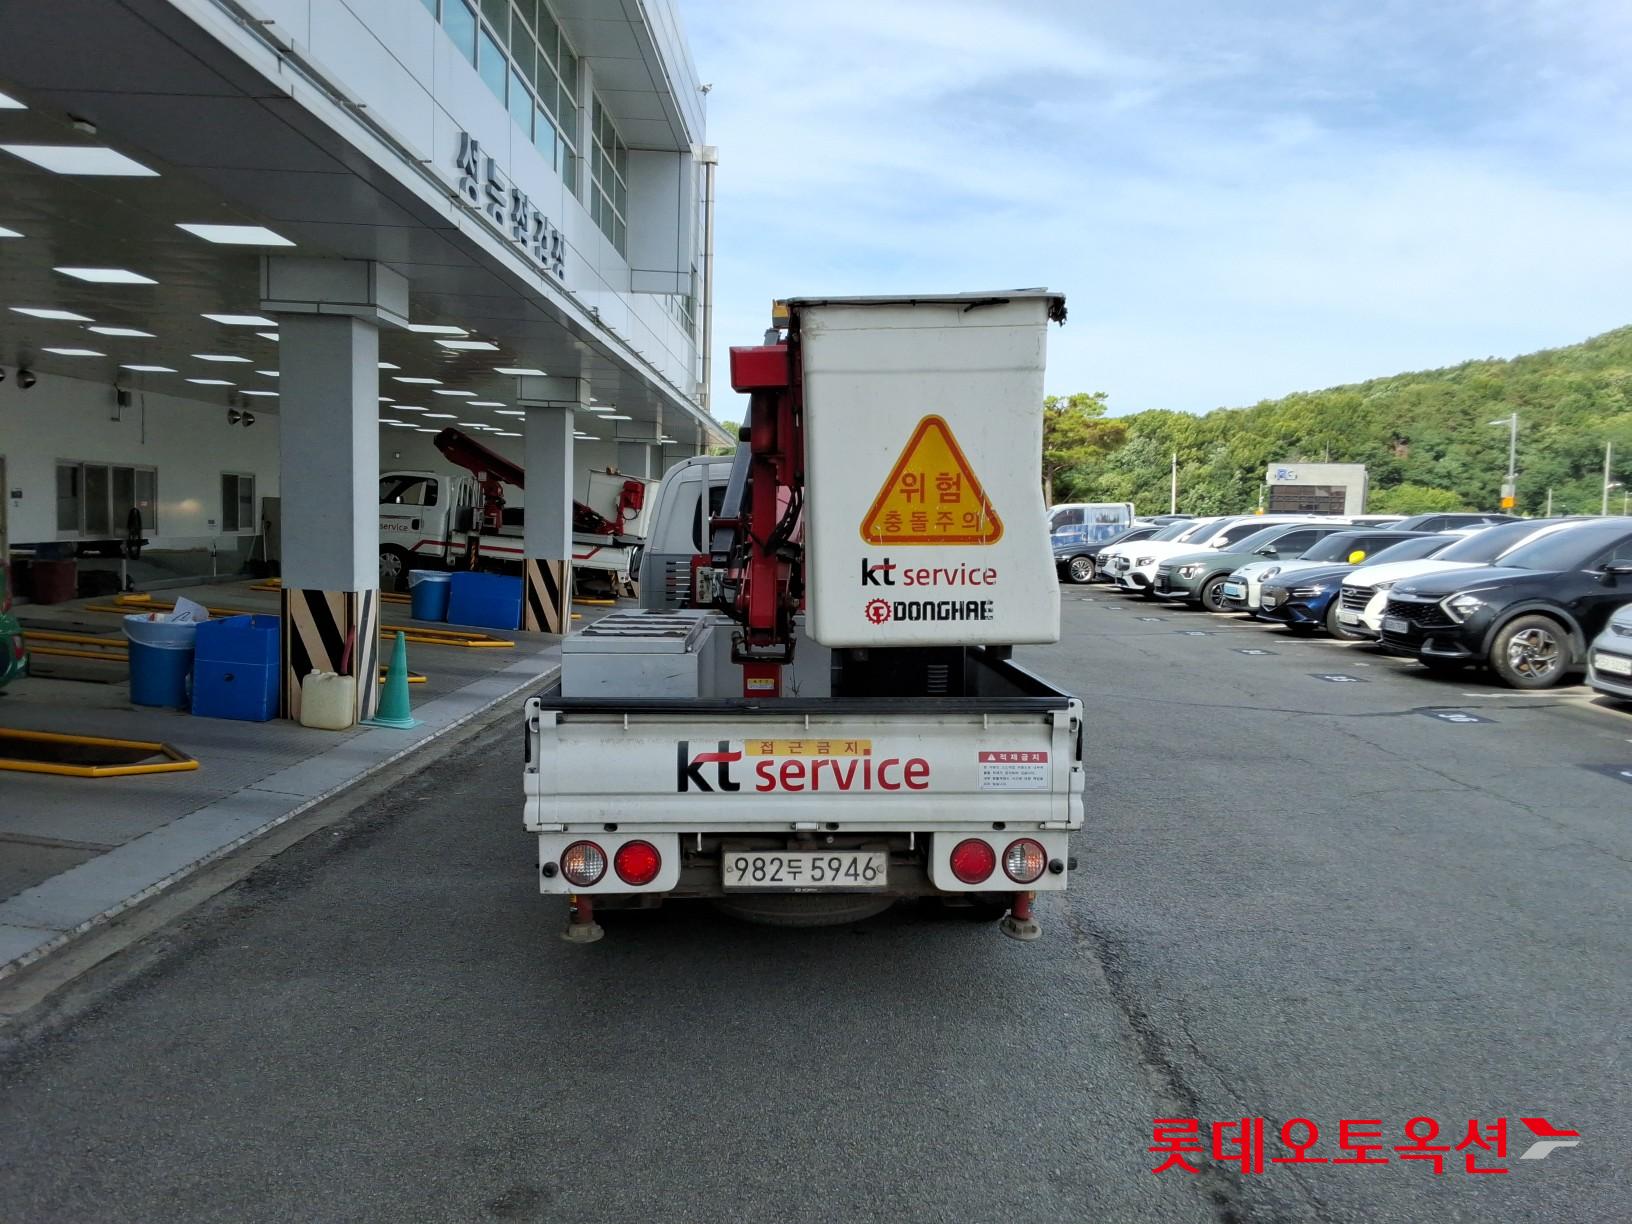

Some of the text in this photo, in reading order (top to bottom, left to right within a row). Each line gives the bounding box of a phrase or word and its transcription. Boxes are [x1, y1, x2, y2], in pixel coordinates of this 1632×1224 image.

[456, 131, 566, 281] 성능점검장
[900, 472, 961, 503] 위험
[883, 510, 980, 533] 충돌주의
[861, 557, 997, 586] kt service
[893, 600, 994, 621] DONGHAE
[760, 741, 858, 755] 접근금지
[677, 740, 742, 792] kt
[755, 748, 930, 792] service
